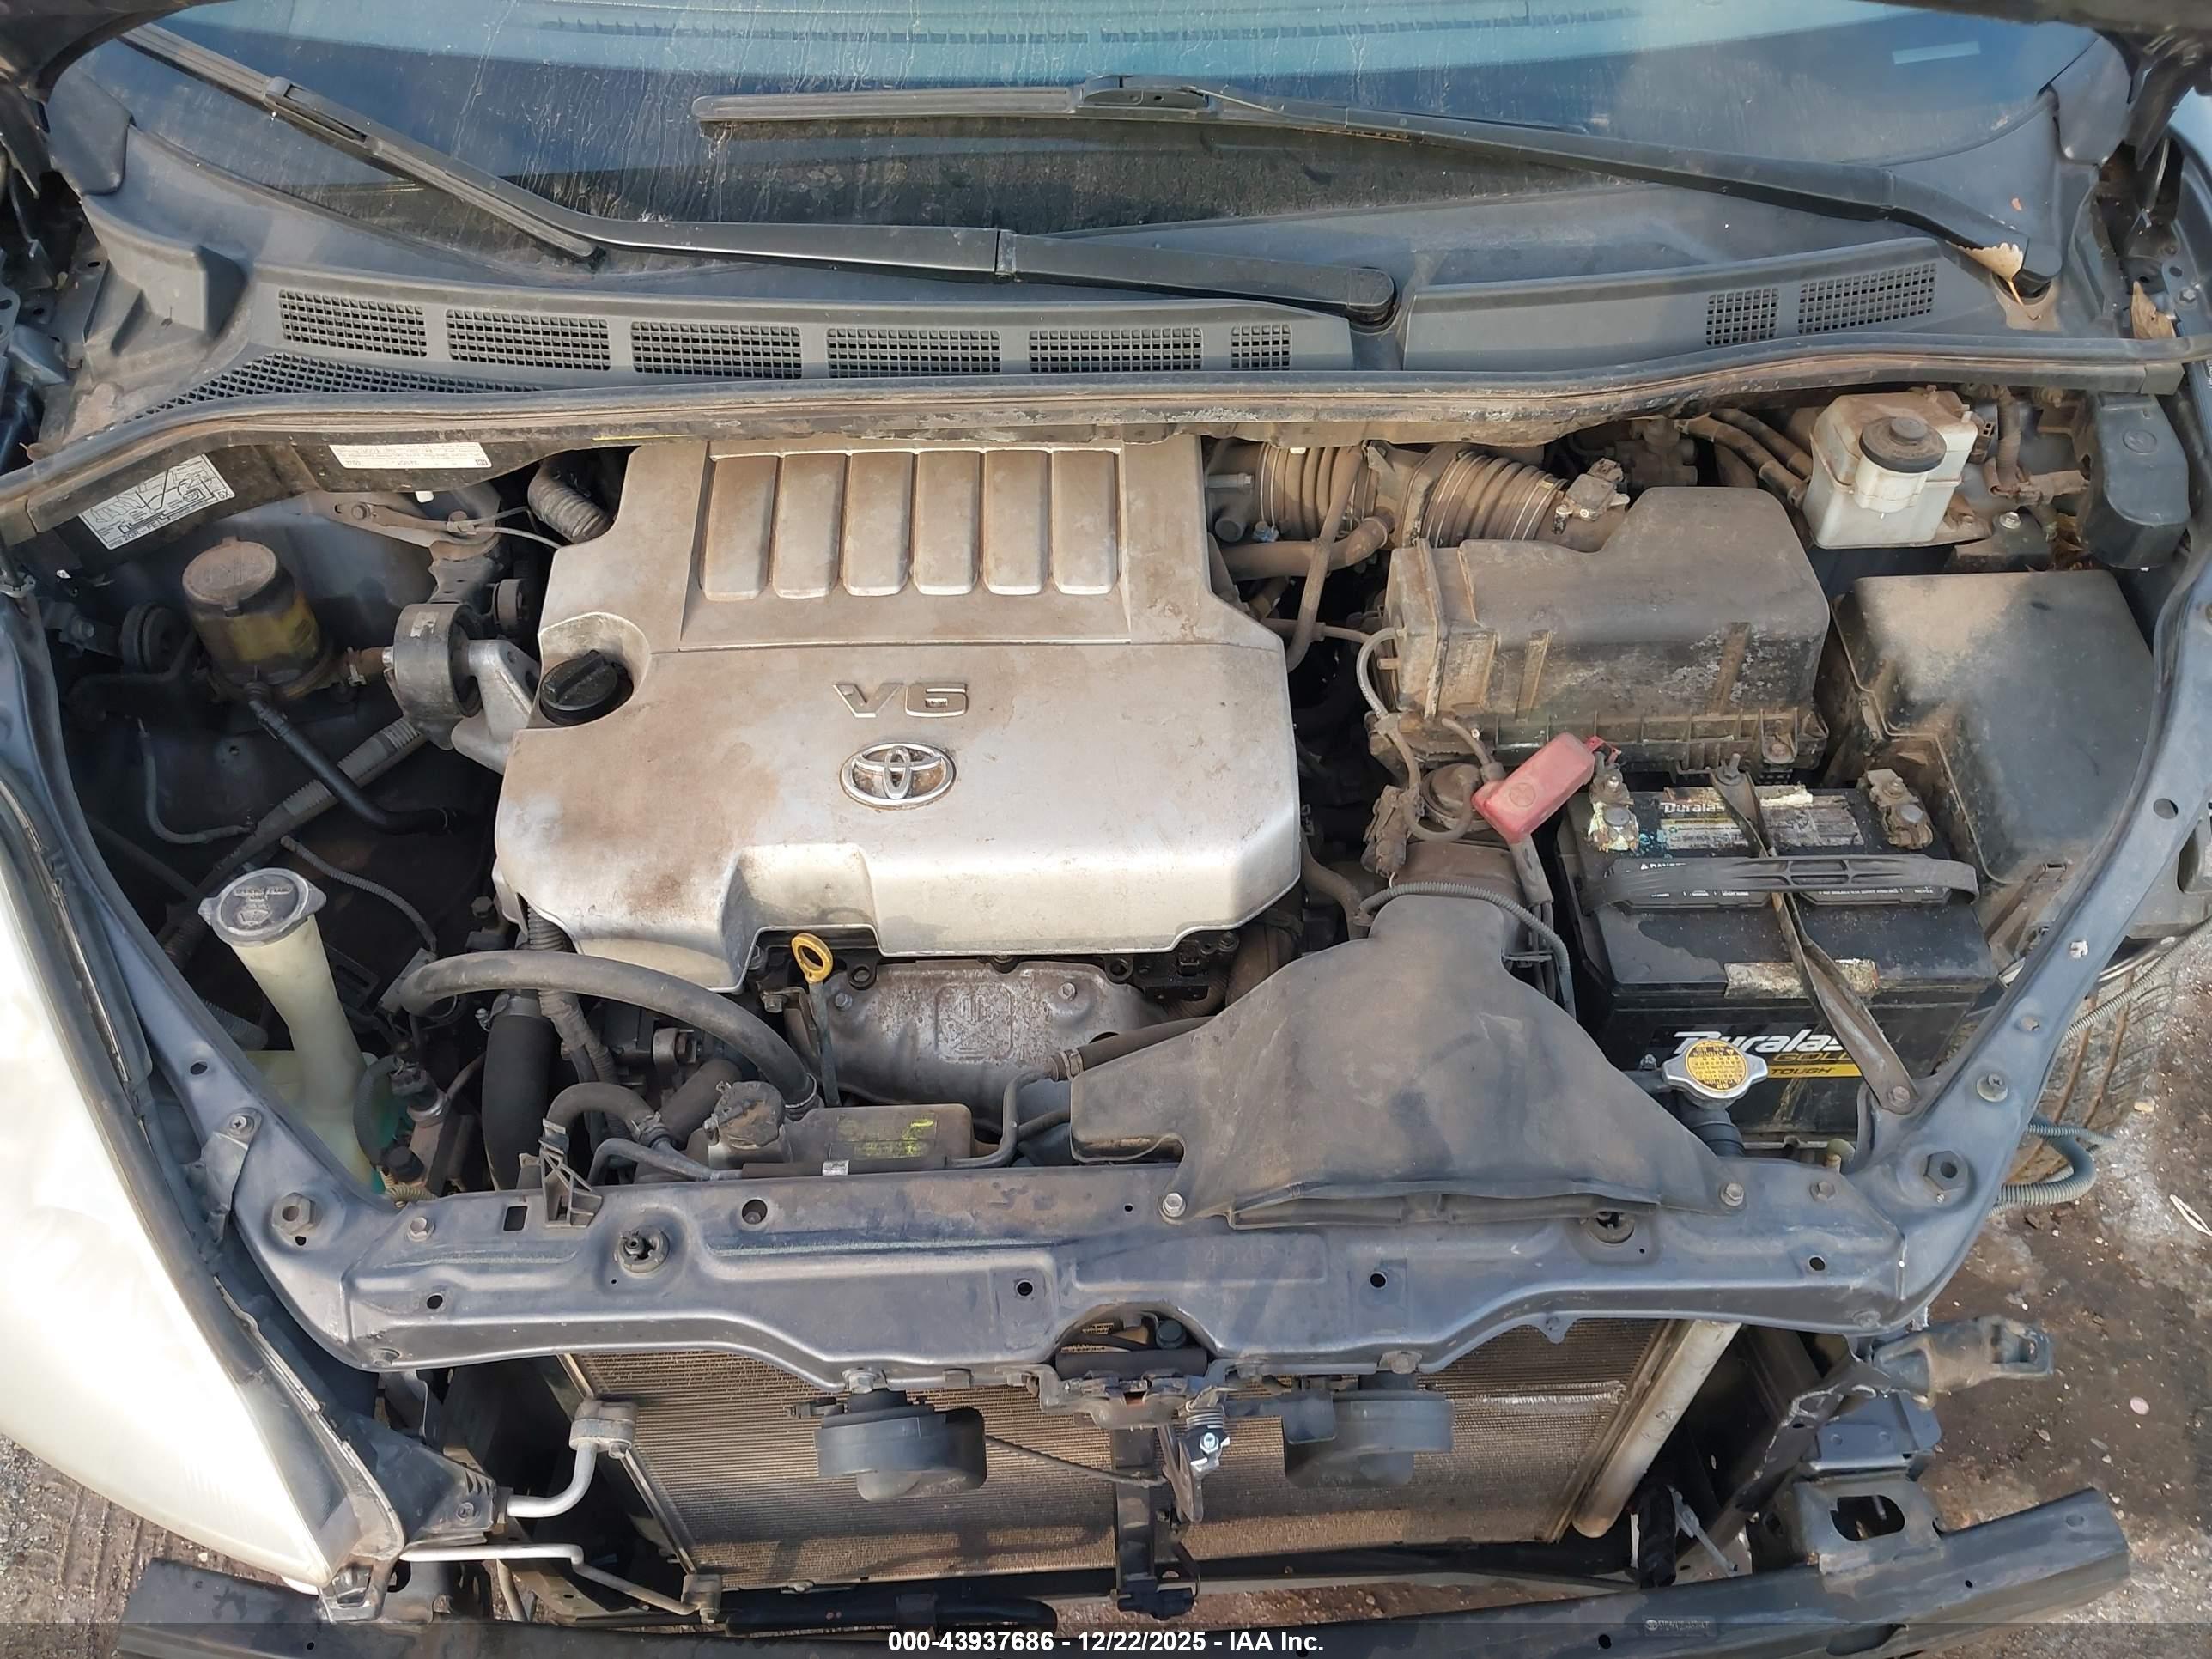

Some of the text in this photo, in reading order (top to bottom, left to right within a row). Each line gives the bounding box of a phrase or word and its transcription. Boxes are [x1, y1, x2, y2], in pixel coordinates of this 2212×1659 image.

[832, 682, 969, 718] V6
[1660, 802, 1725, 813] Duralas
[1674, 1029, 1844, 1054] Duralas
